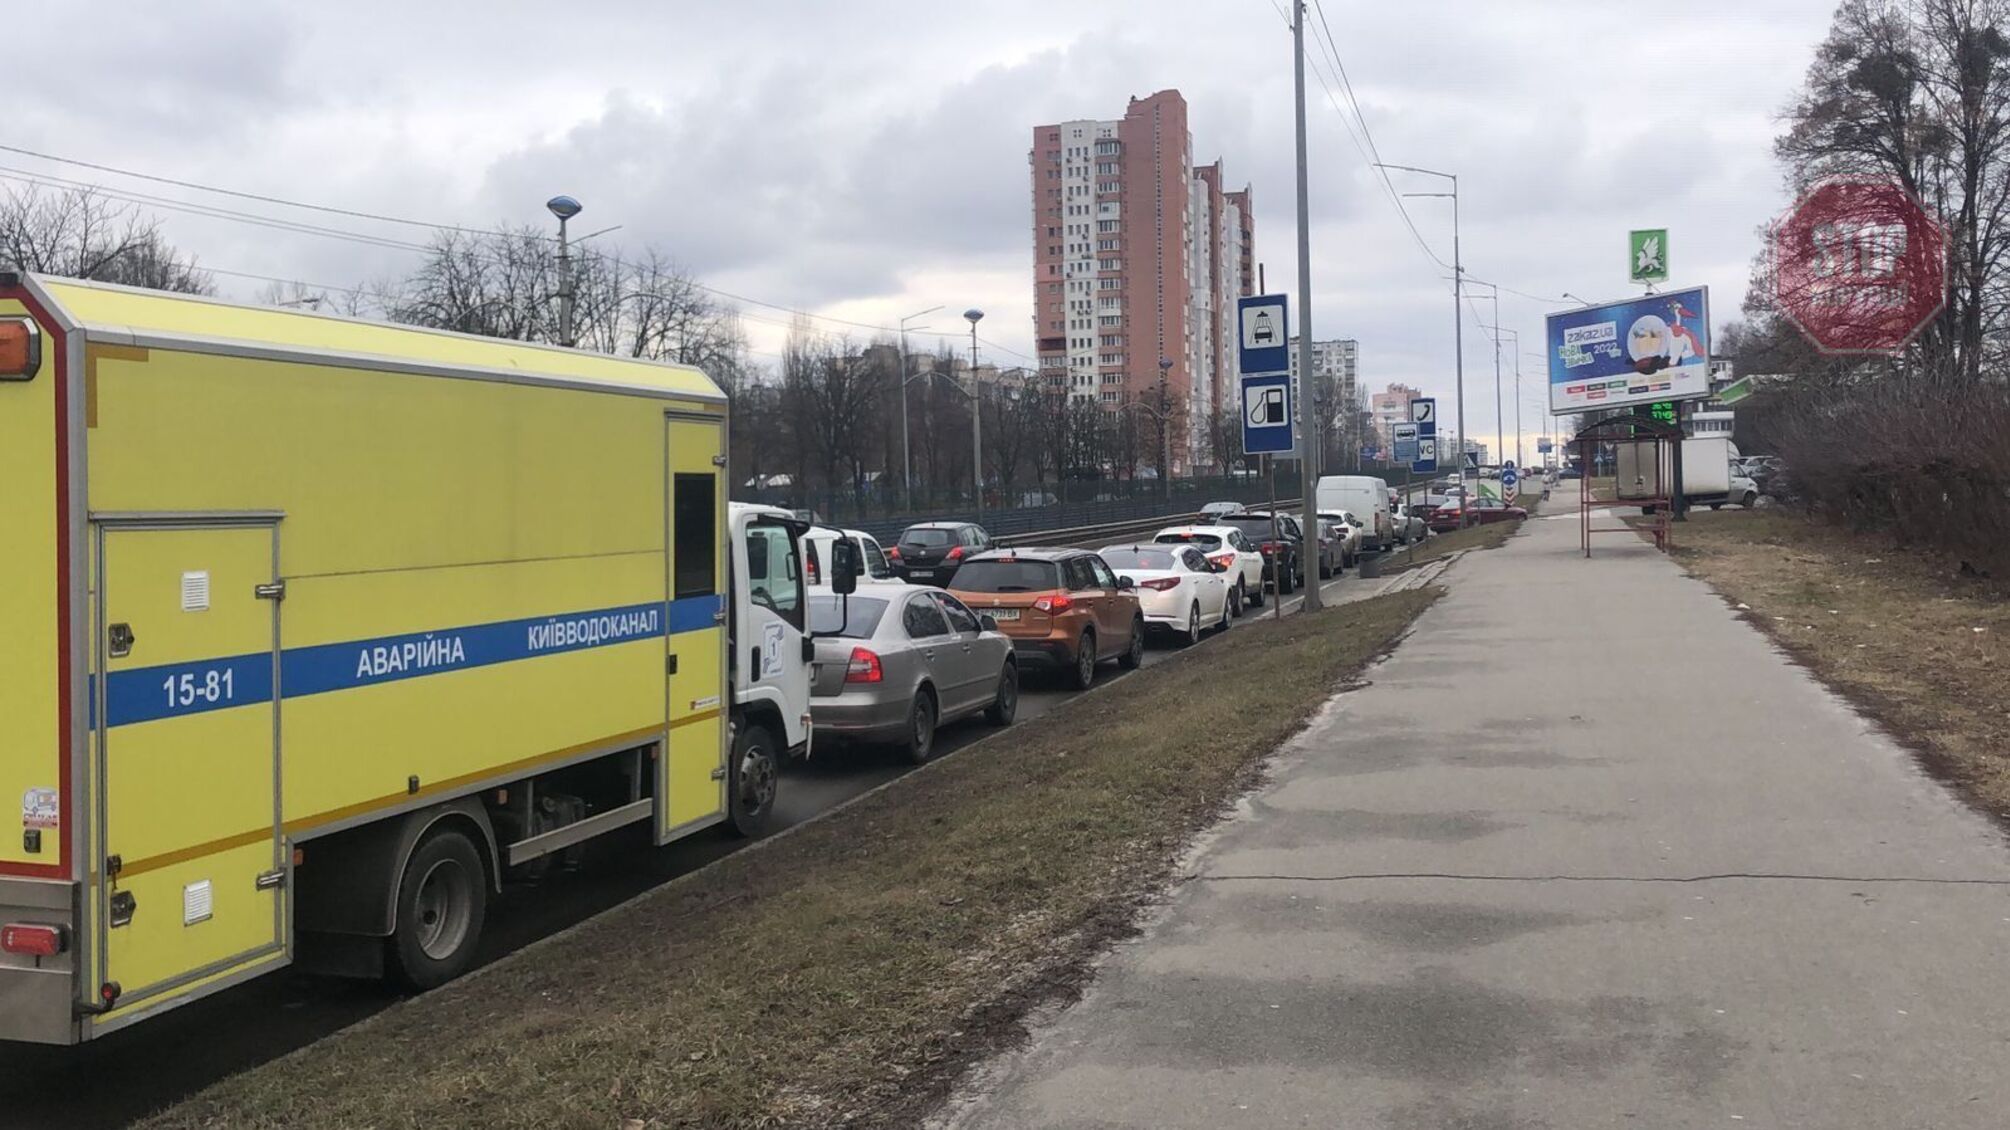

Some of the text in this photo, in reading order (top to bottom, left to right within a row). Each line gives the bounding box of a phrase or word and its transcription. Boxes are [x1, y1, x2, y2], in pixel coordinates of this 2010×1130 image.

[527, 610, 658, 651] КИЇВВОДОКАНАЛ
[356, 635, 466, 679] АВАРІЙНА
[163, 669, 234, 707] 15-81
